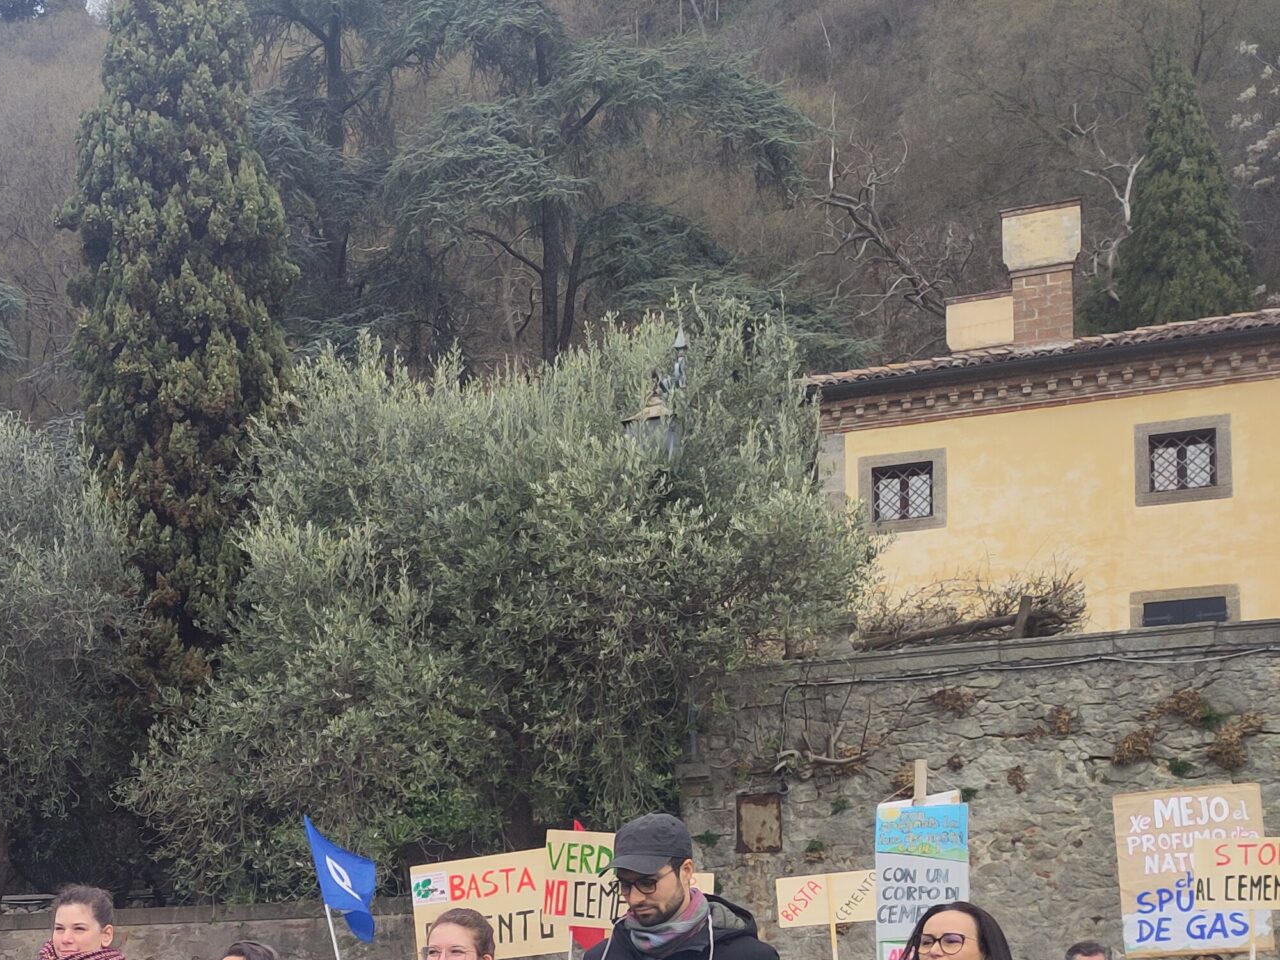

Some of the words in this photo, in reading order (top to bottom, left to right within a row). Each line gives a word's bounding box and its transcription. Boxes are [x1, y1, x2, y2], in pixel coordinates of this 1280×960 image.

[1153, 795, 1230, 828] MEJO
[1232, 800, 1251, 821] el
[1126, 828, 1226, 856] PROFUMO
[1215, 842, 1280, 867] STO
[547, 841, 618, 875] VERD
[1144, 852, 1195, 875] NAT
[450, 865, 537, 901] BASTA
[882, 866, 917, 884] CON
[925, 867, 950, 884] UN
[1195, 877, 1216, 902] AL
[544, 879, 569, 916] NO
[780, 880, 823, 922] BASTA
[835, 871, 876, 921] CEMENTO
[945, 886, 960, 901] DI
[1135, 917, 1173, 943] DE
[1186, 911, 1250, 941] GAS
